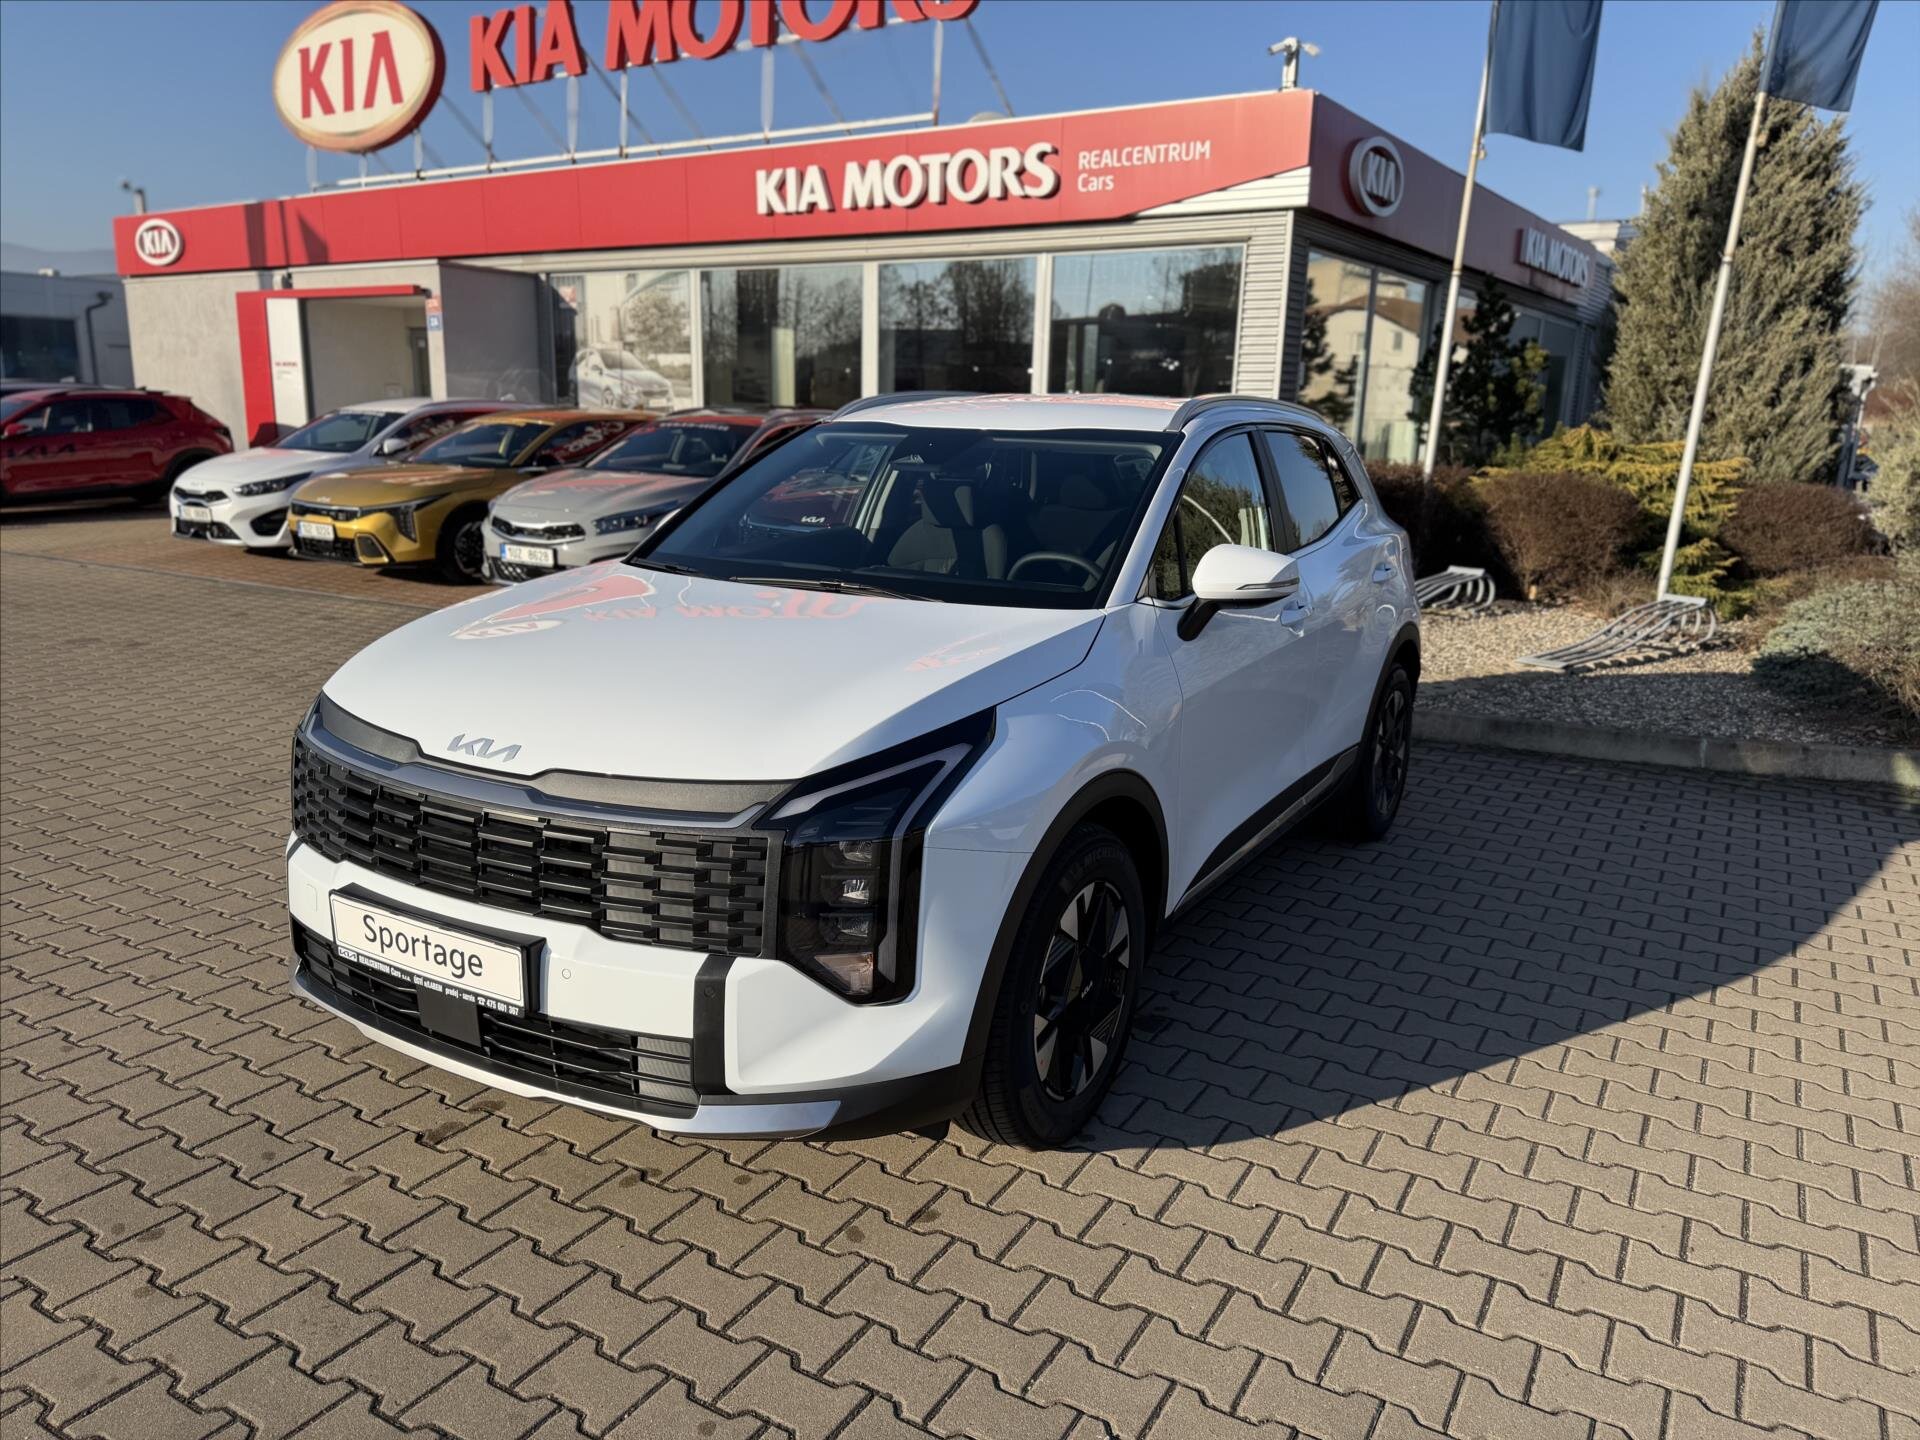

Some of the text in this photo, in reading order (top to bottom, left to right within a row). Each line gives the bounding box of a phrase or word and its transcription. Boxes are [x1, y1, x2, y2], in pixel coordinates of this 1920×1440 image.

[469, 0, 586, 92] KIA
[298, 30, 404, 119] KIA
[755, 142, 1058, 215] KIA MOTORS
[1077, 173, 1114, 192] Cars
[1078, 140, 1211, 171] REALCENTRUM
[1367, 151, 1397, 201] KIA
[143, 229, 174, 254] KIA
[1526, 228, 1590, 288] KIA MOTORS
[446, 733, 522, 763] KIA
[363, 914, 483, 979] Sportage
